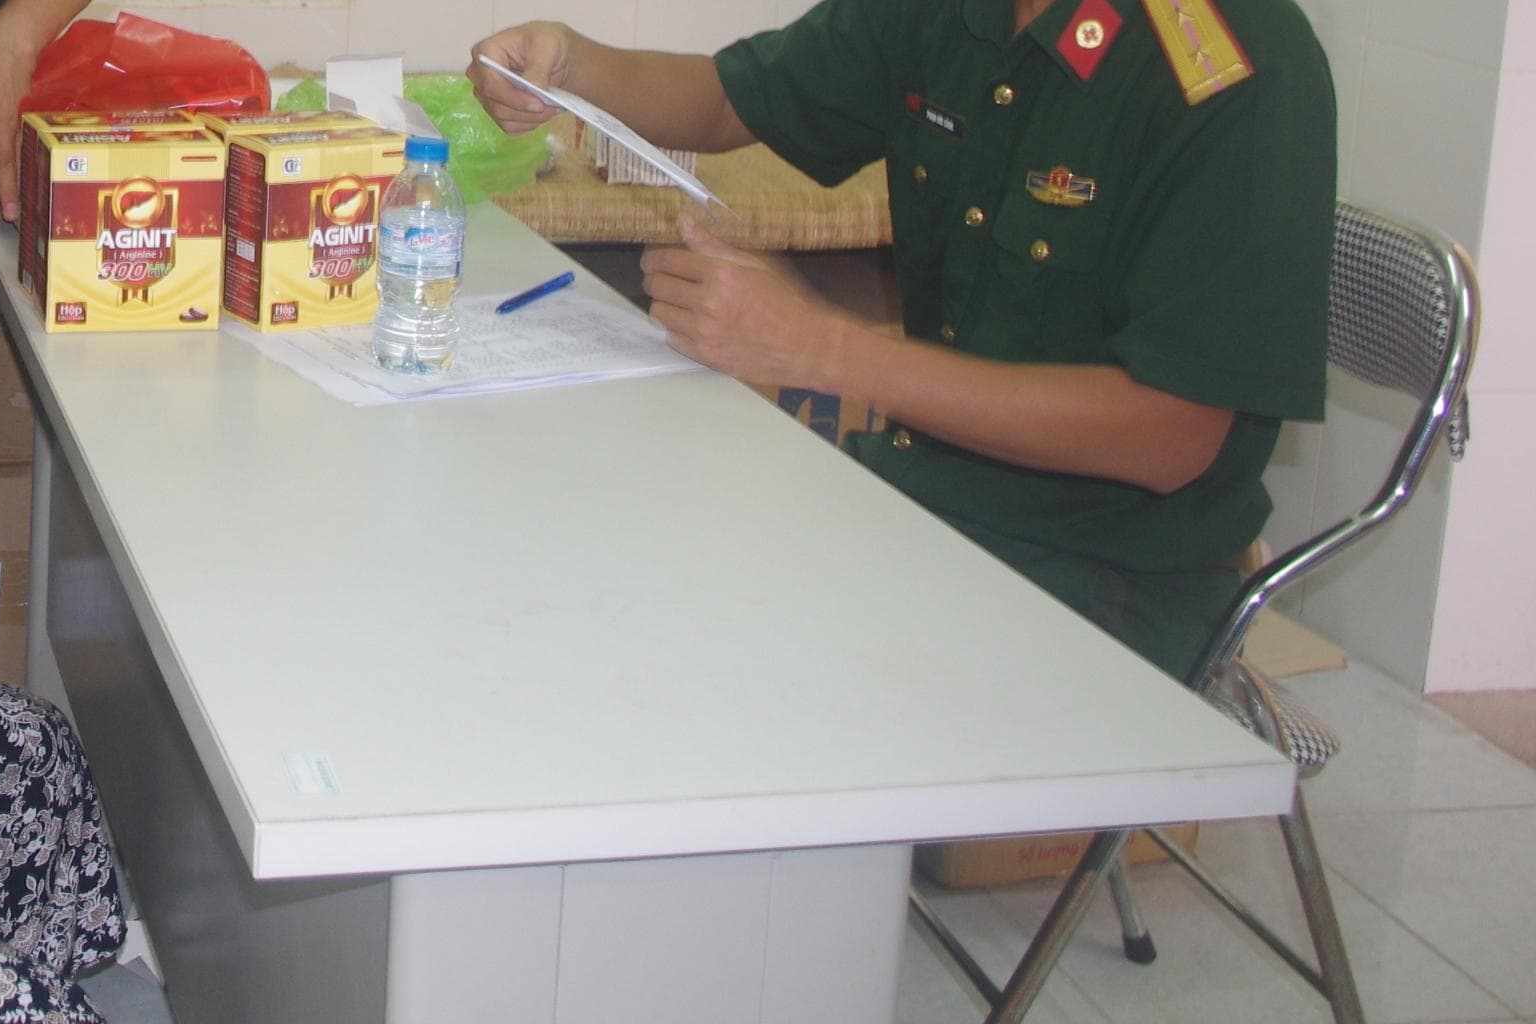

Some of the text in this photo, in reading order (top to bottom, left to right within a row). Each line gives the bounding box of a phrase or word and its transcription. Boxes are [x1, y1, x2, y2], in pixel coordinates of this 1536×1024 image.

[96, 228, 177, 249] AGINIT
[309, 223, 378, 248] AGINIT
[60, 303, 83, 316] Hộp
